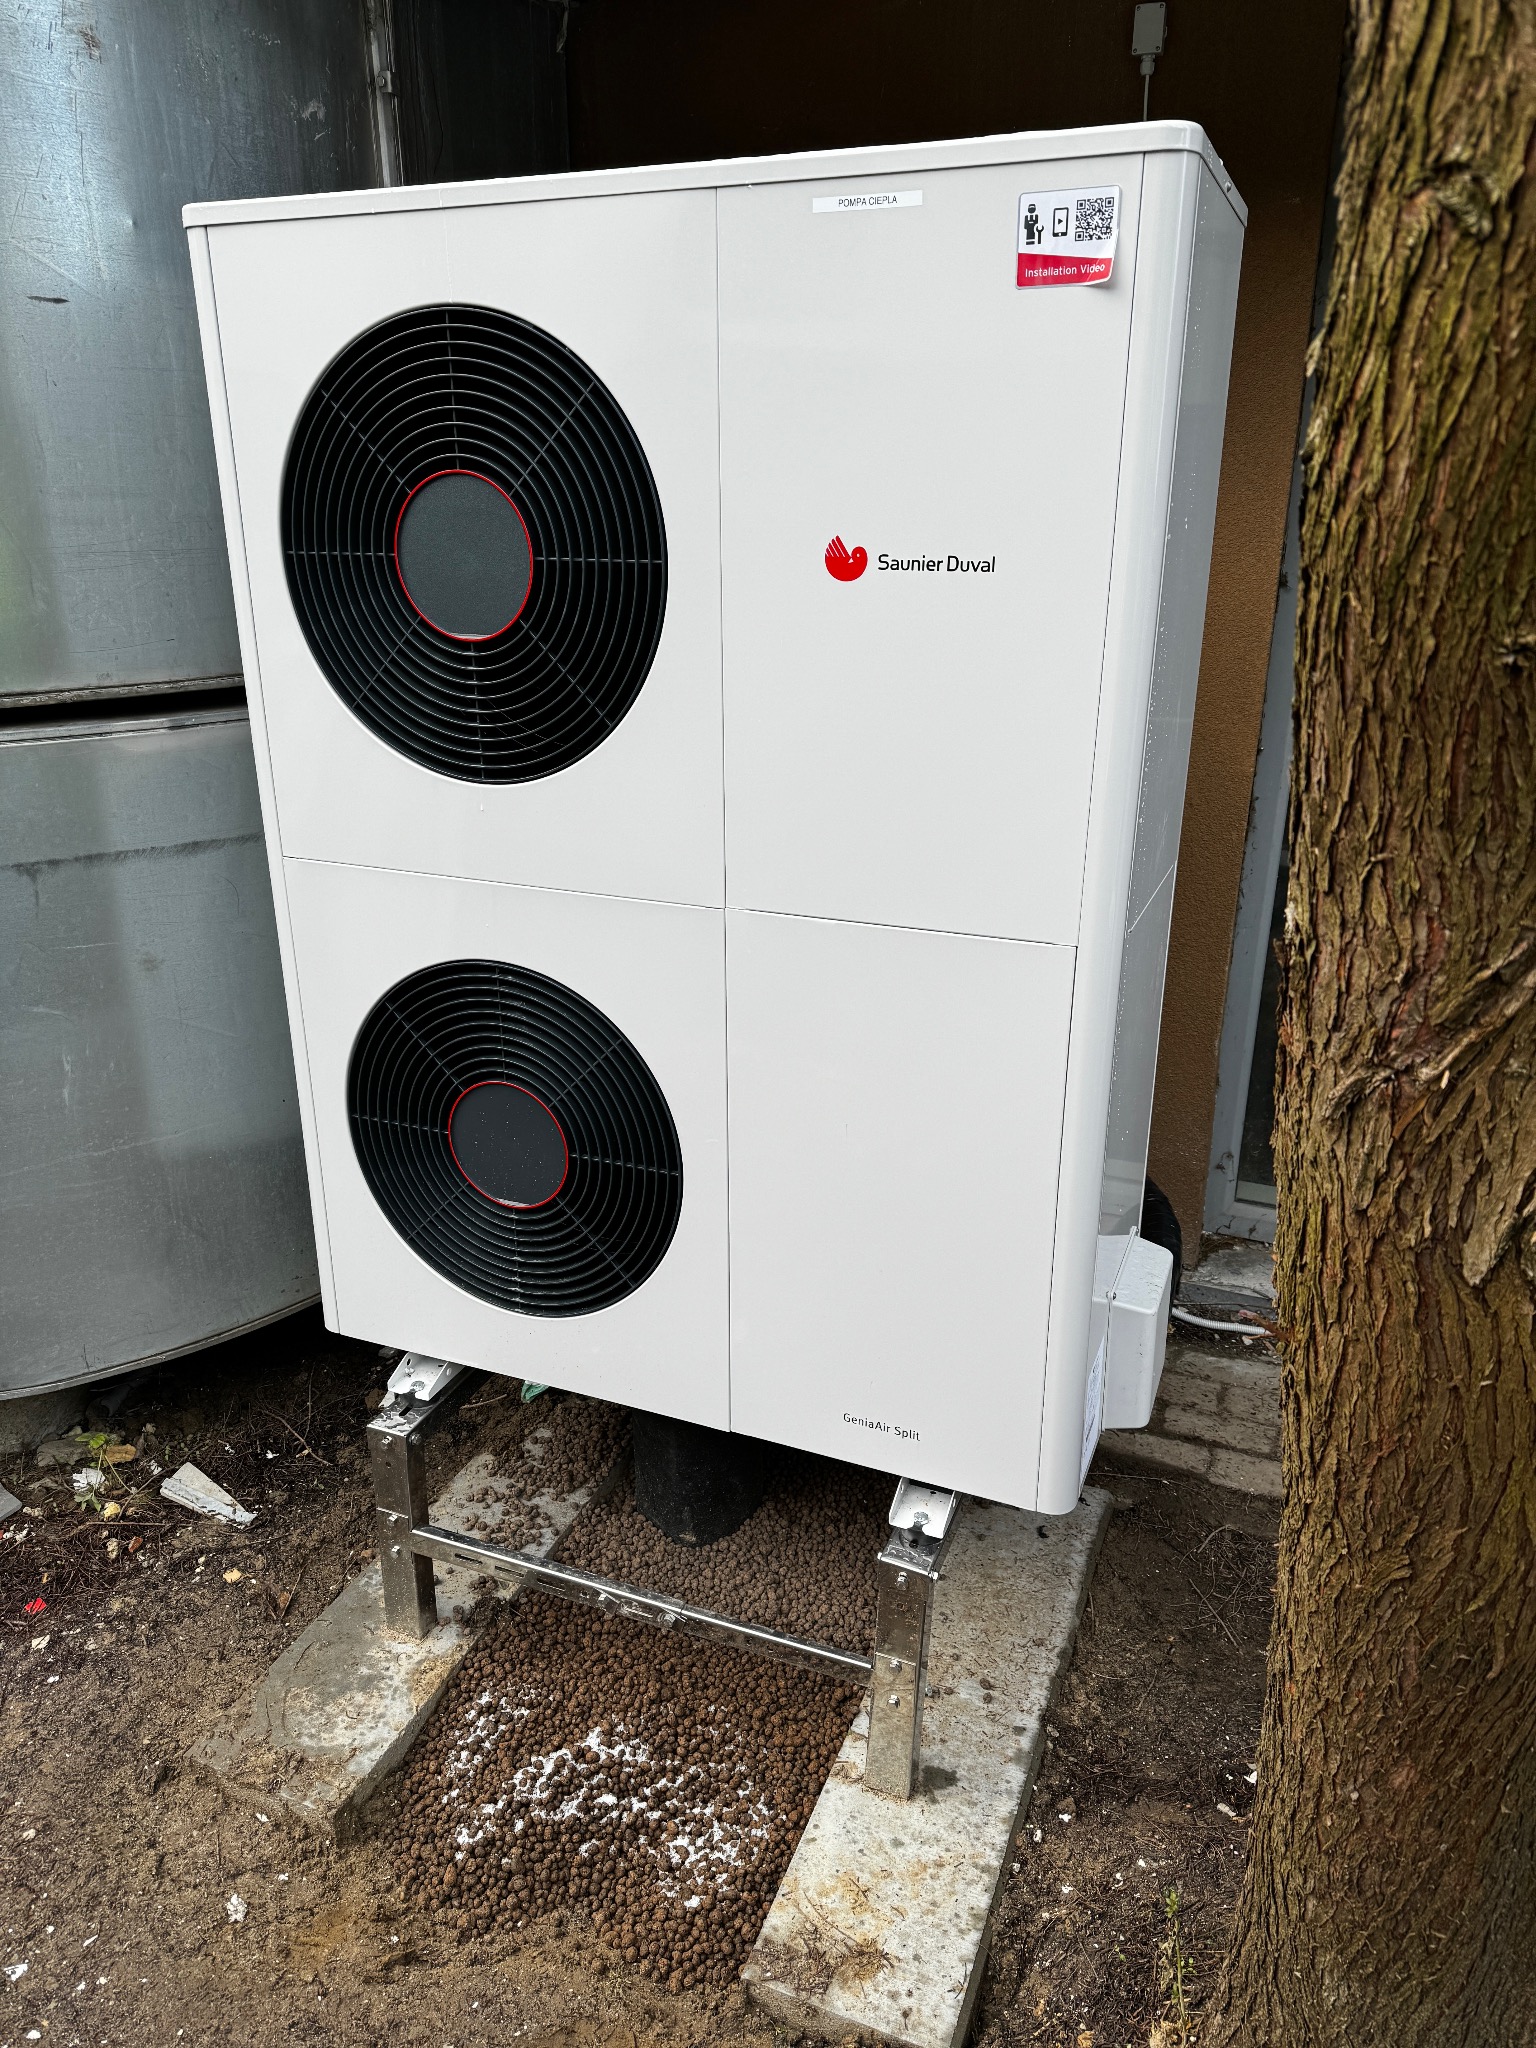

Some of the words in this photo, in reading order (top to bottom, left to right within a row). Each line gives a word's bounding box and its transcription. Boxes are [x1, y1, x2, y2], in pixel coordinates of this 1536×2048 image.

[838, 198, 867, 208] POMPA
[1025, 265, 1077, 278] Installation
[1080, 263, 1106, 275] Video
[877, 553, 944, 572] Saunier
[946, 555, 996, 573] Duval
[843, 1413, 891, 1433] GeniaAir
[894, 1426, 921, 1442] Split
